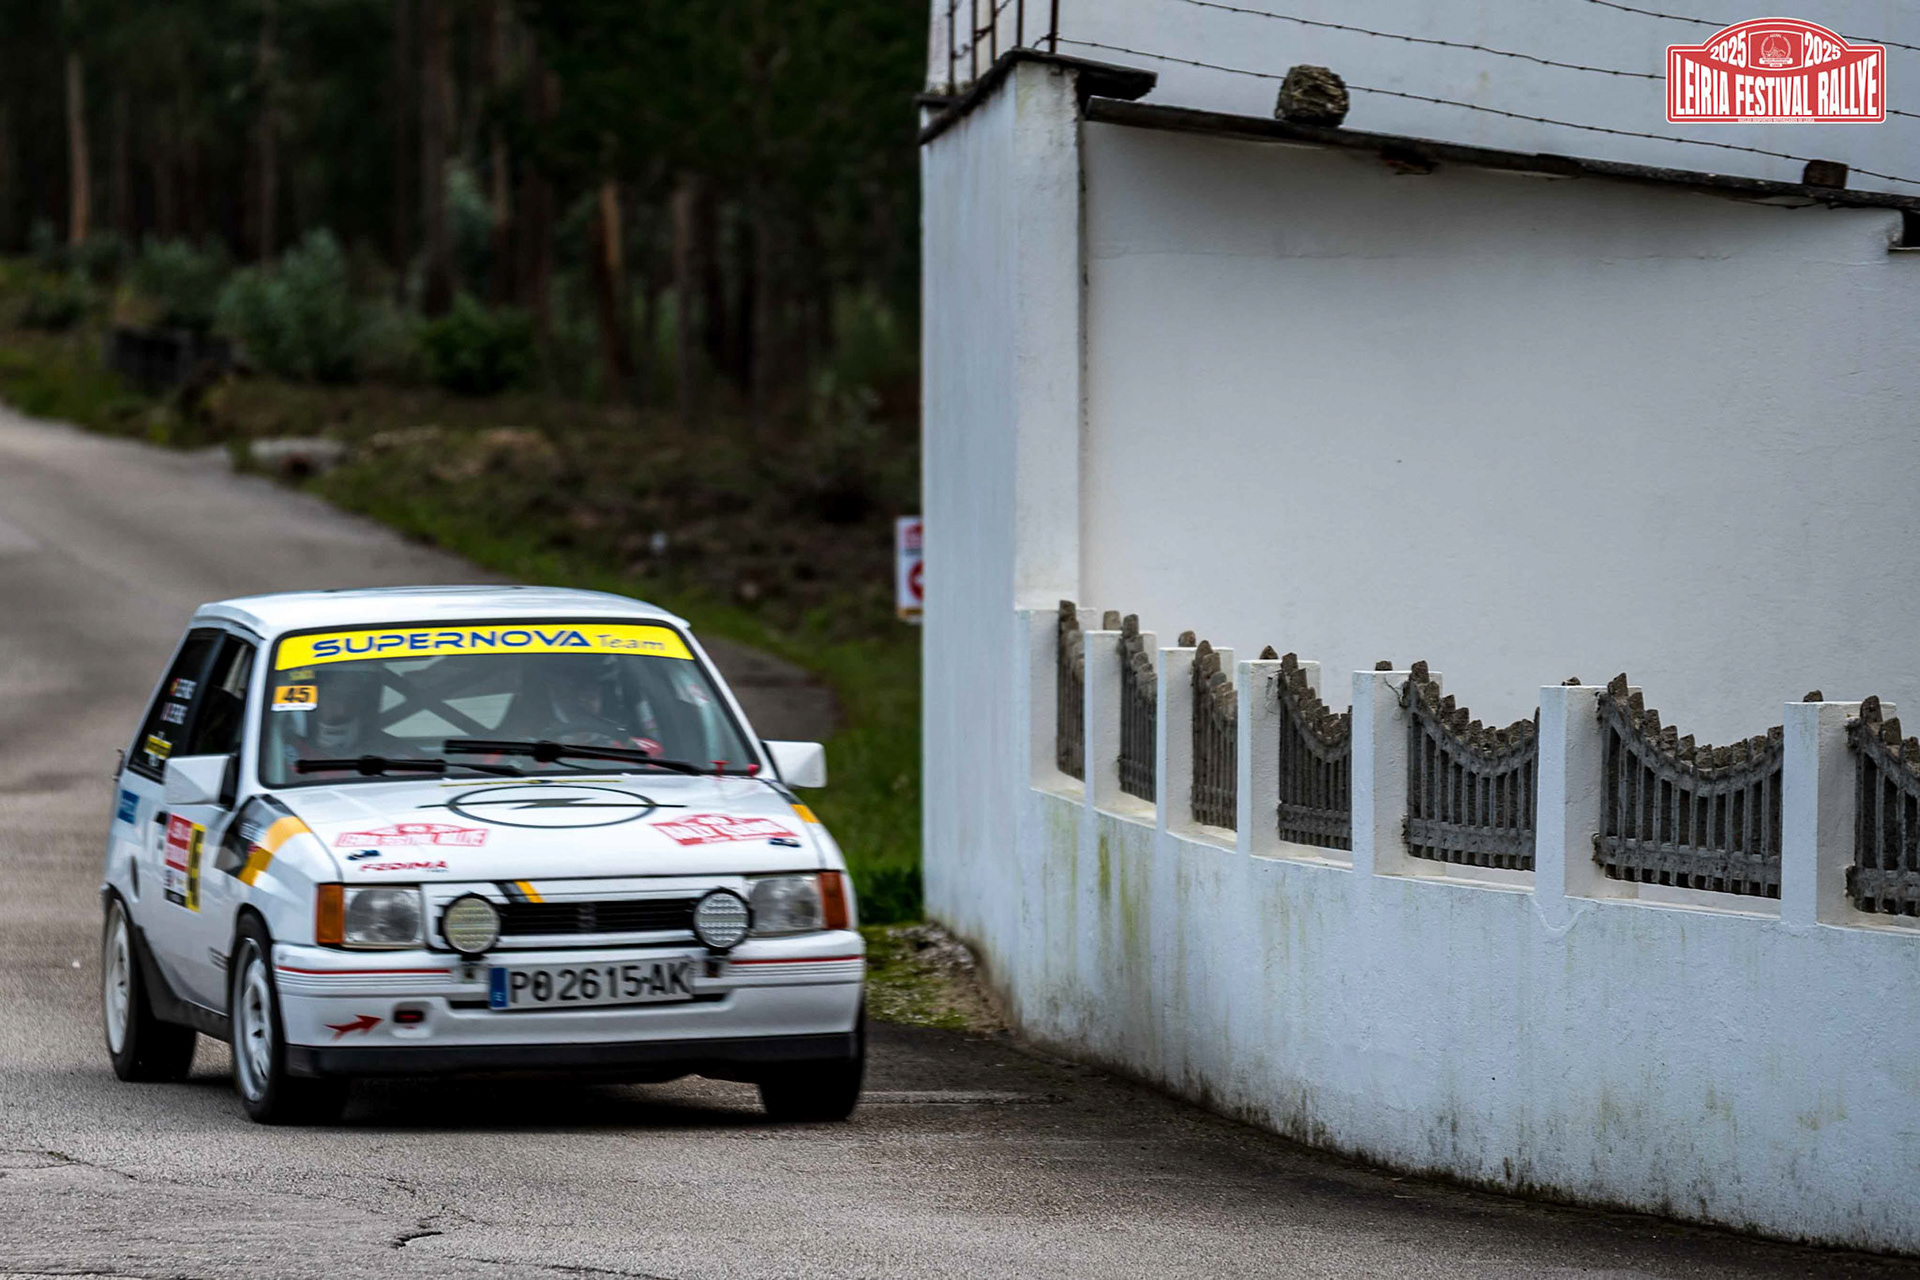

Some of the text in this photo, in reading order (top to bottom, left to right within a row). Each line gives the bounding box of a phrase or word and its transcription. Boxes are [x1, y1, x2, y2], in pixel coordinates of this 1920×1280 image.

[311, 631, 666, 658] SUPERNOVA Team
[284, 687, 311, 703] 45
